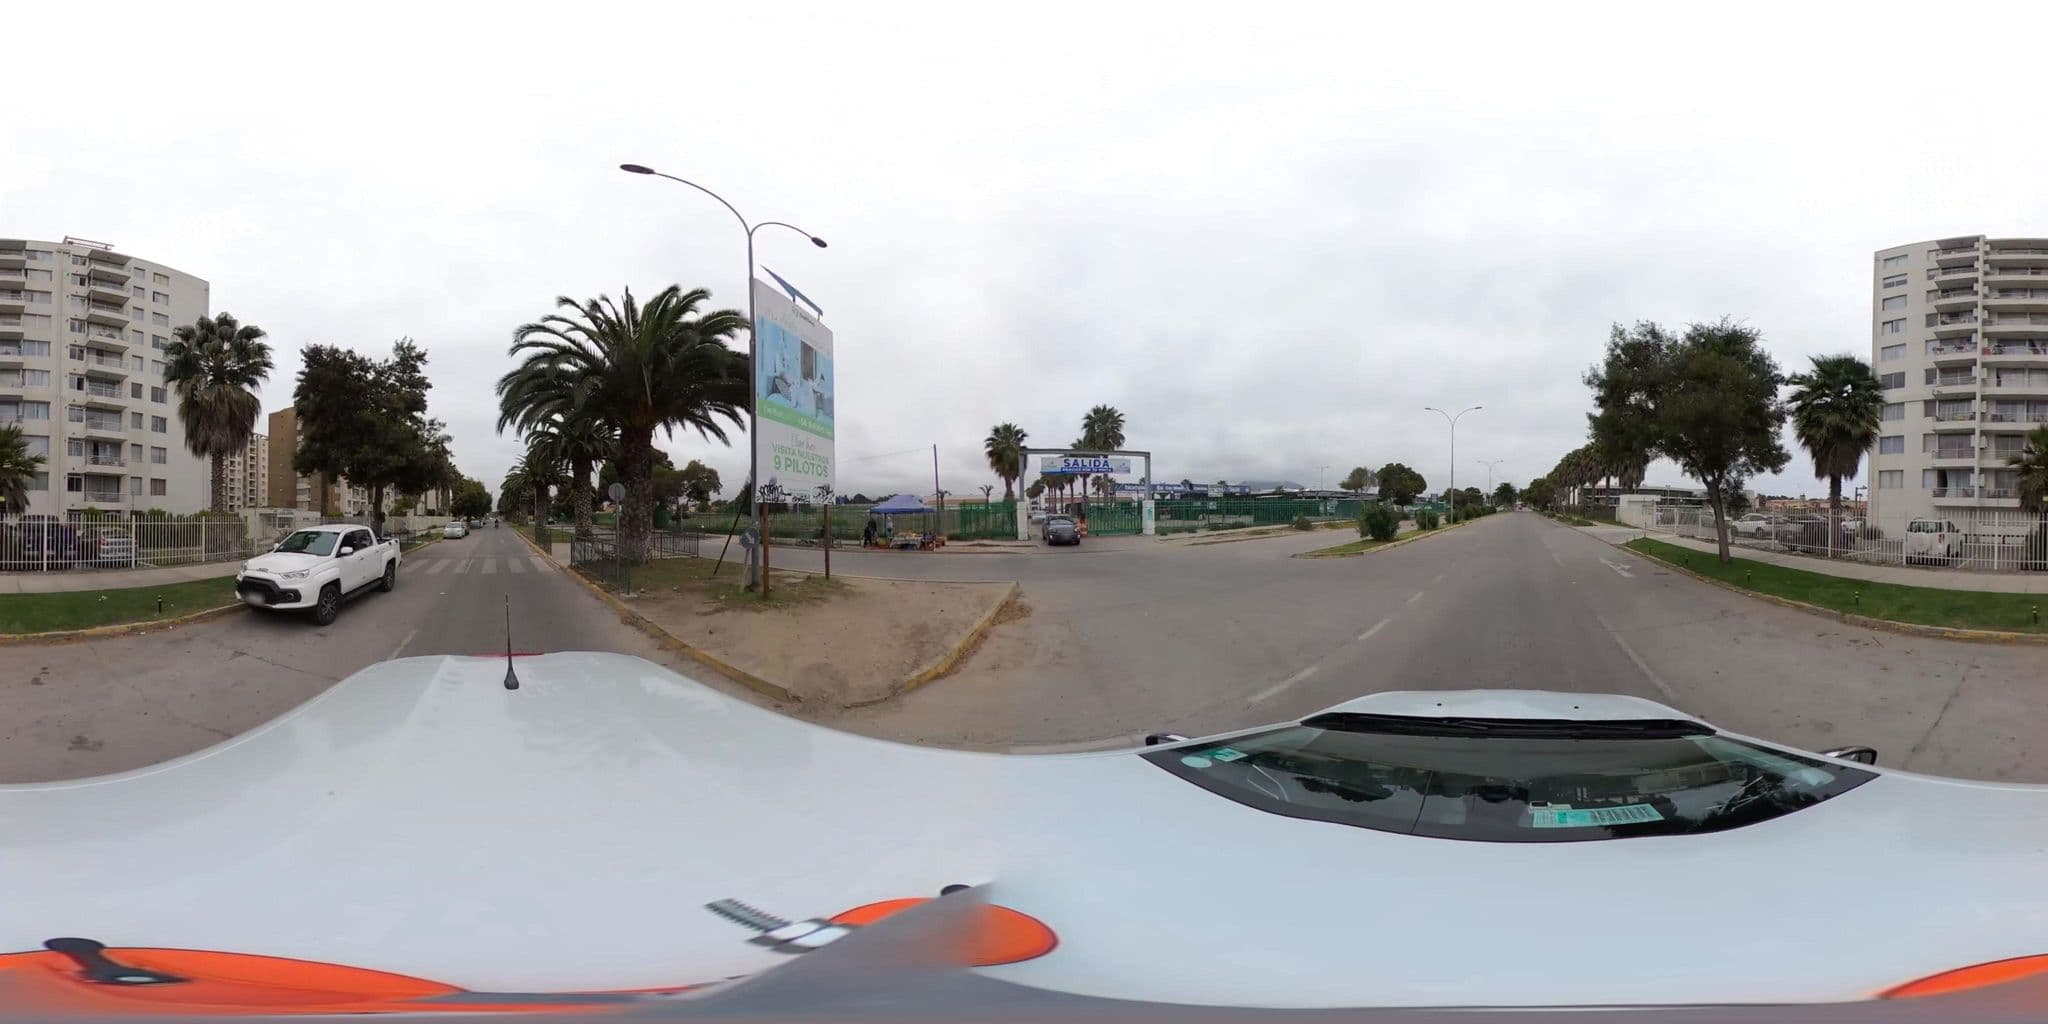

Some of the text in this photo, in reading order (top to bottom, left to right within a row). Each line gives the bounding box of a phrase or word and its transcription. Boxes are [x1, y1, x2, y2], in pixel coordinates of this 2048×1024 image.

[774, 455, 829, 477] 9 PILOTOS
[1063, 459, 1110, 467] SALIDA
